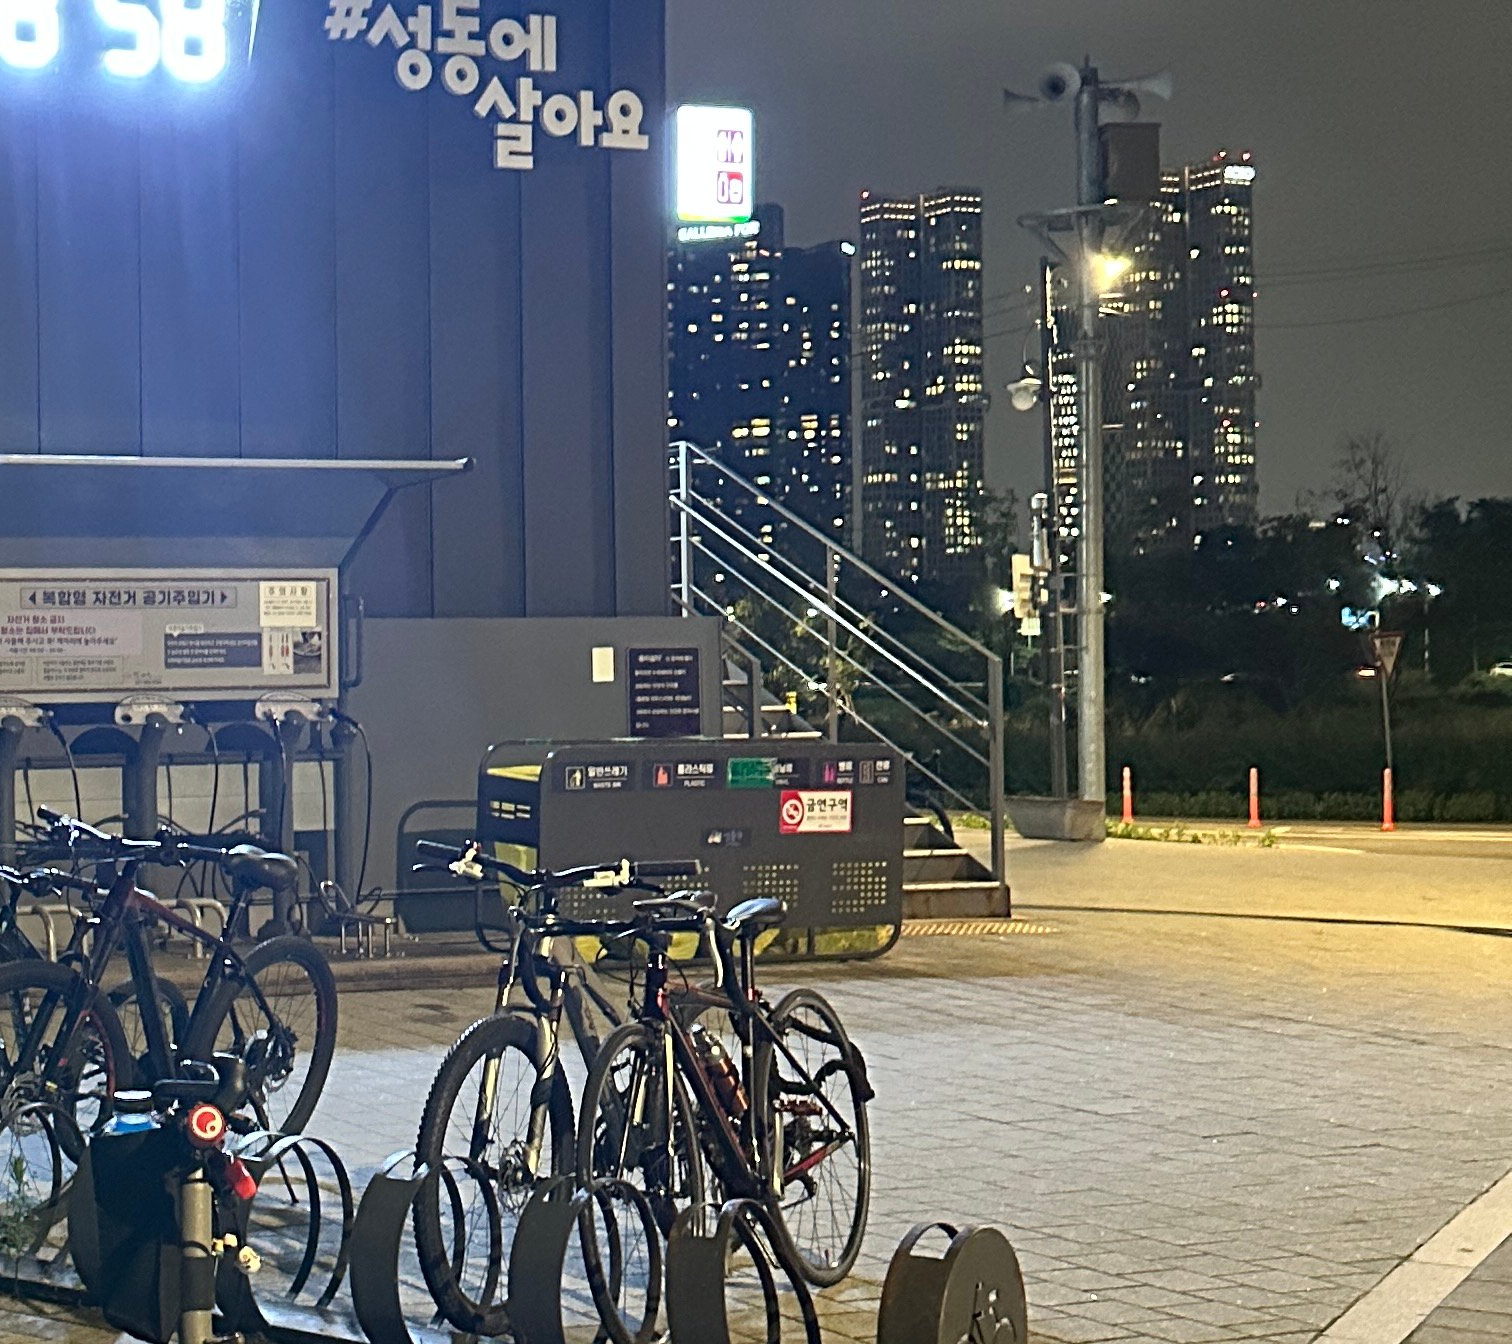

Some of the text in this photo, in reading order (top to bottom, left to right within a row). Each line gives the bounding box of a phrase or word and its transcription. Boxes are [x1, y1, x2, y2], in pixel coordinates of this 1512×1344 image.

[474, 77, 650, 170] 살아요
[93, 590, 137, 606] 자전거
[143, 590, 215, 606] 공기주입기
[806, 797, 848, 812] 금연구역
